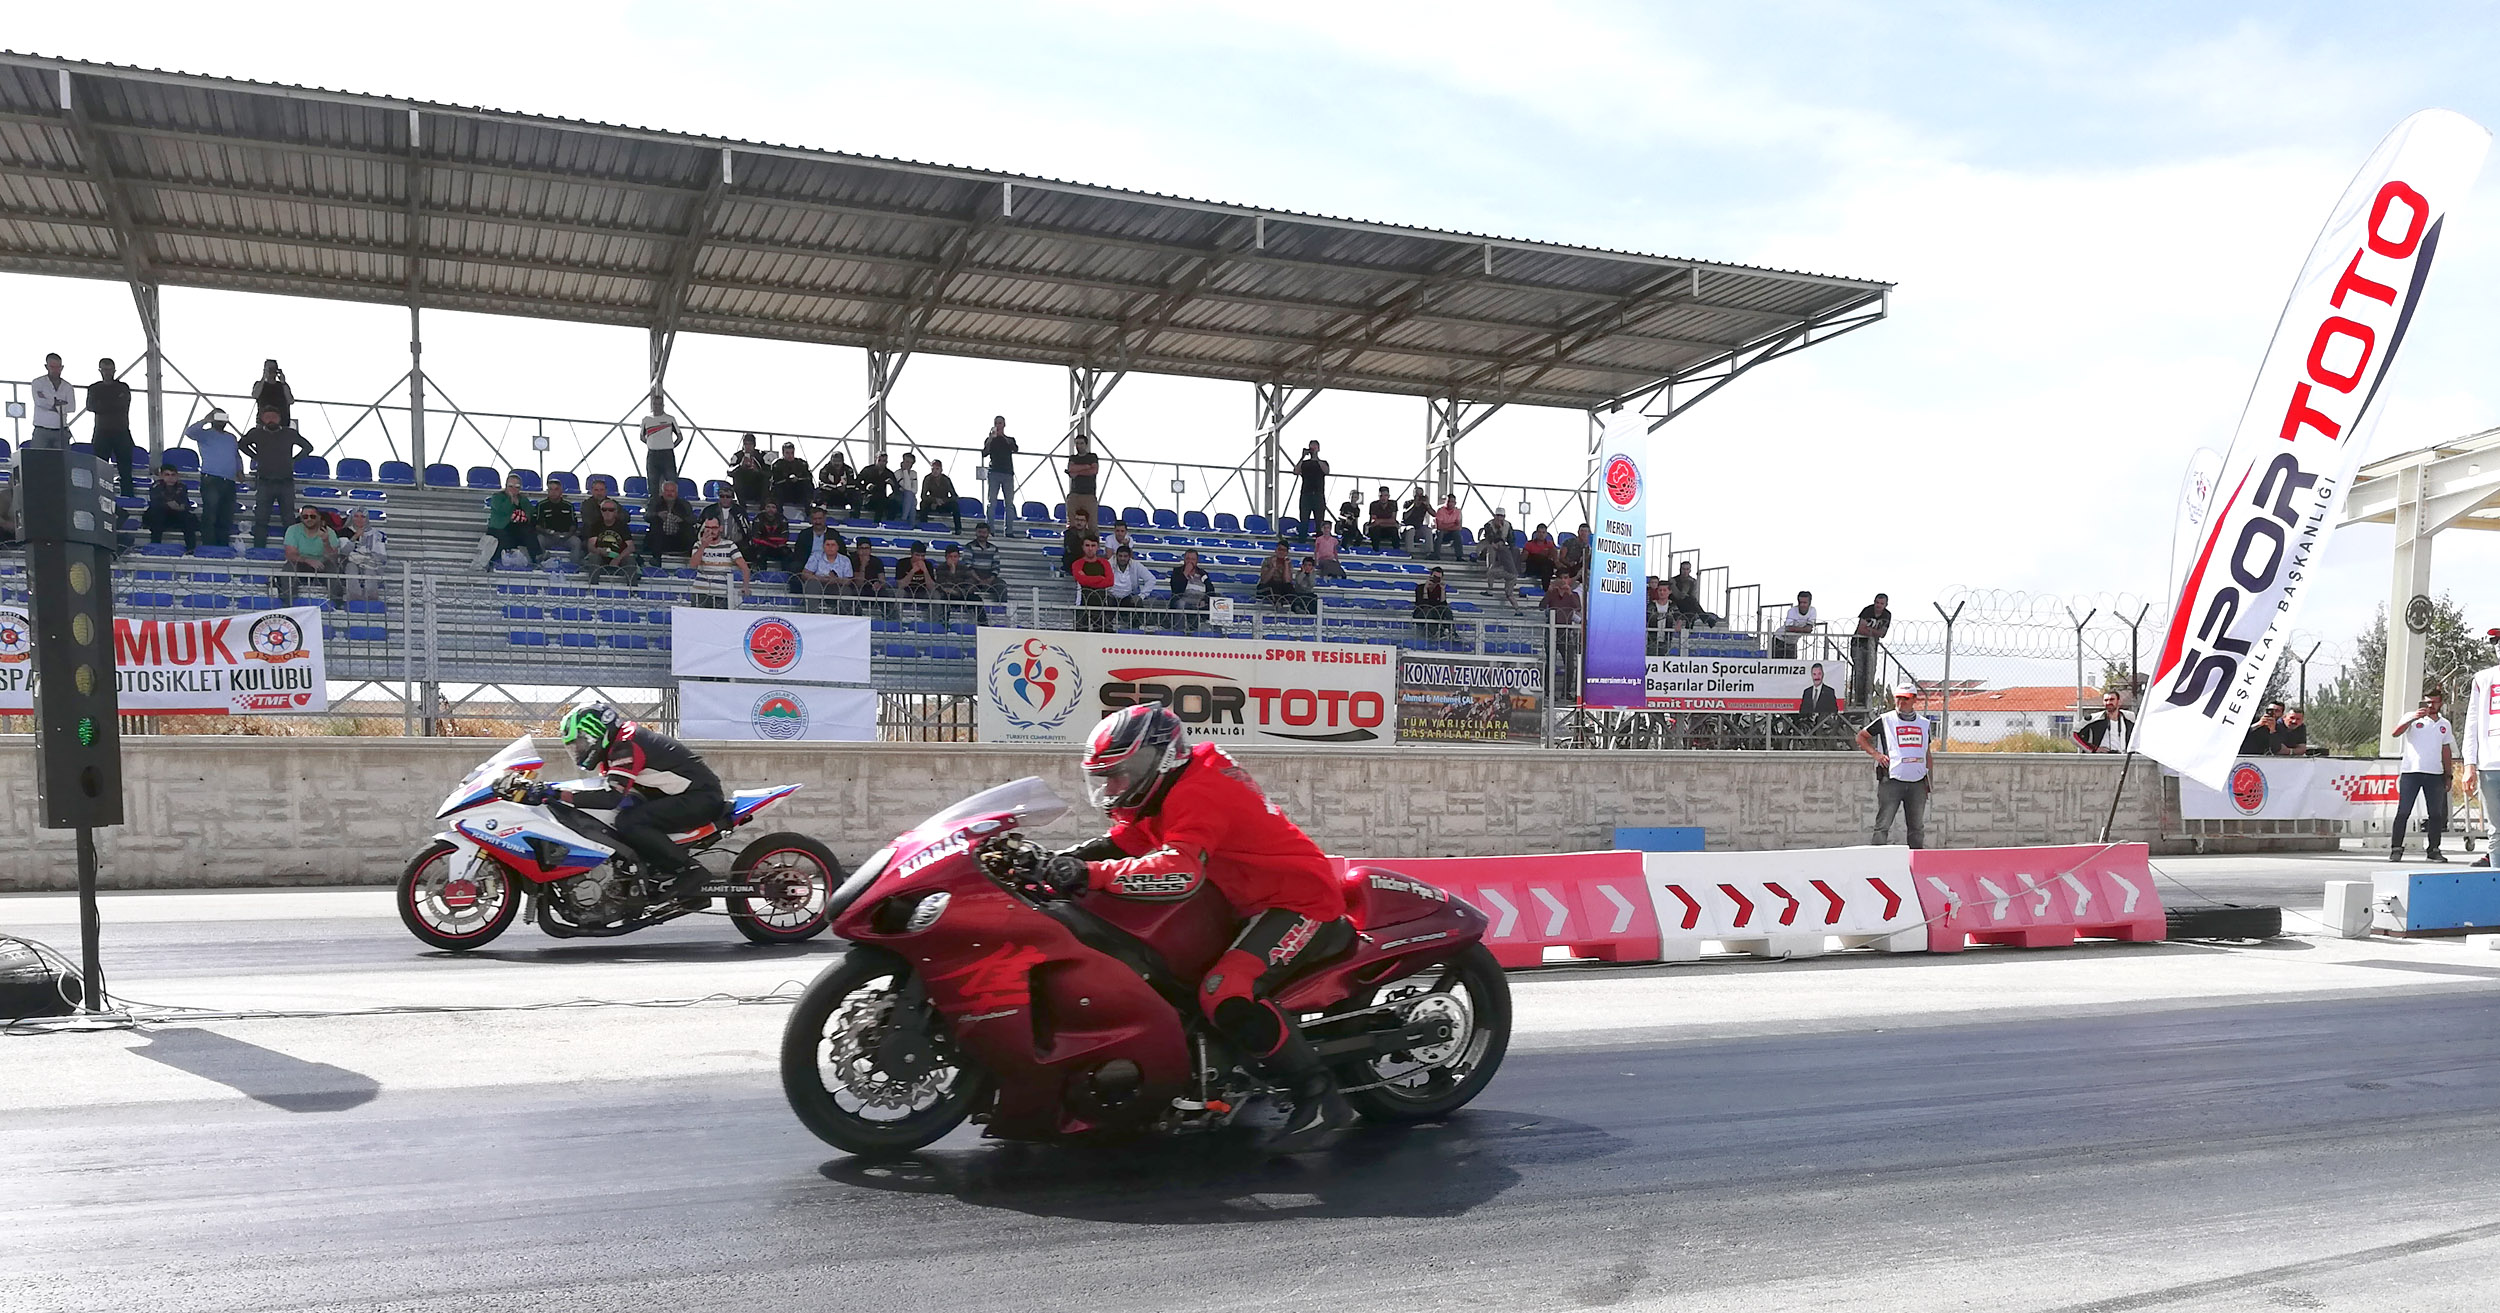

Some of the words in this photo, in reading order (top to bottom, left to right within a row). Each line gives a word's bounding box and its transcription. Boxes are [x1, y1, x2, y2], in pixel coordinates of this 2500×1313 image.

[1606, 559, 1627, 575] SPOR
[1600, 577, 1632, 595] KULÜBÜ
[1265, 648, 1306, 662] SPOR
[1312, 648, 1387, 665] TESİSLERİ
[1663, 660, 1708, 674] Katılan
[230, 665, 312, 691] KULÜBÜ
[1404, 662, 1451, 685] KONYA
[1454, 665, 1490, 687] ZEVK
[1492, 667, 1541, 688] MOTOR
[1646, 678, 1704, 694] Başarılar
[1707, 679, 1754, 692] Dilerim
[256, 696, 288, 706] TMF
[1647, 697, 1681, 709] amit
[1684, 699, 1726, 709] TUNA
[1403, 716, 1428, 727] TÜM
[1186, 726, 1245, 736] ŞKANLIĞI
[2358, 779, 2395, 795] TMF
[501, 841, 527, 854] TUNA
[1111, 872, 1195, 885] ARLEN
[730, 885, 755, 893] TUNA
[1122, 882, 1187, 894] NESS
